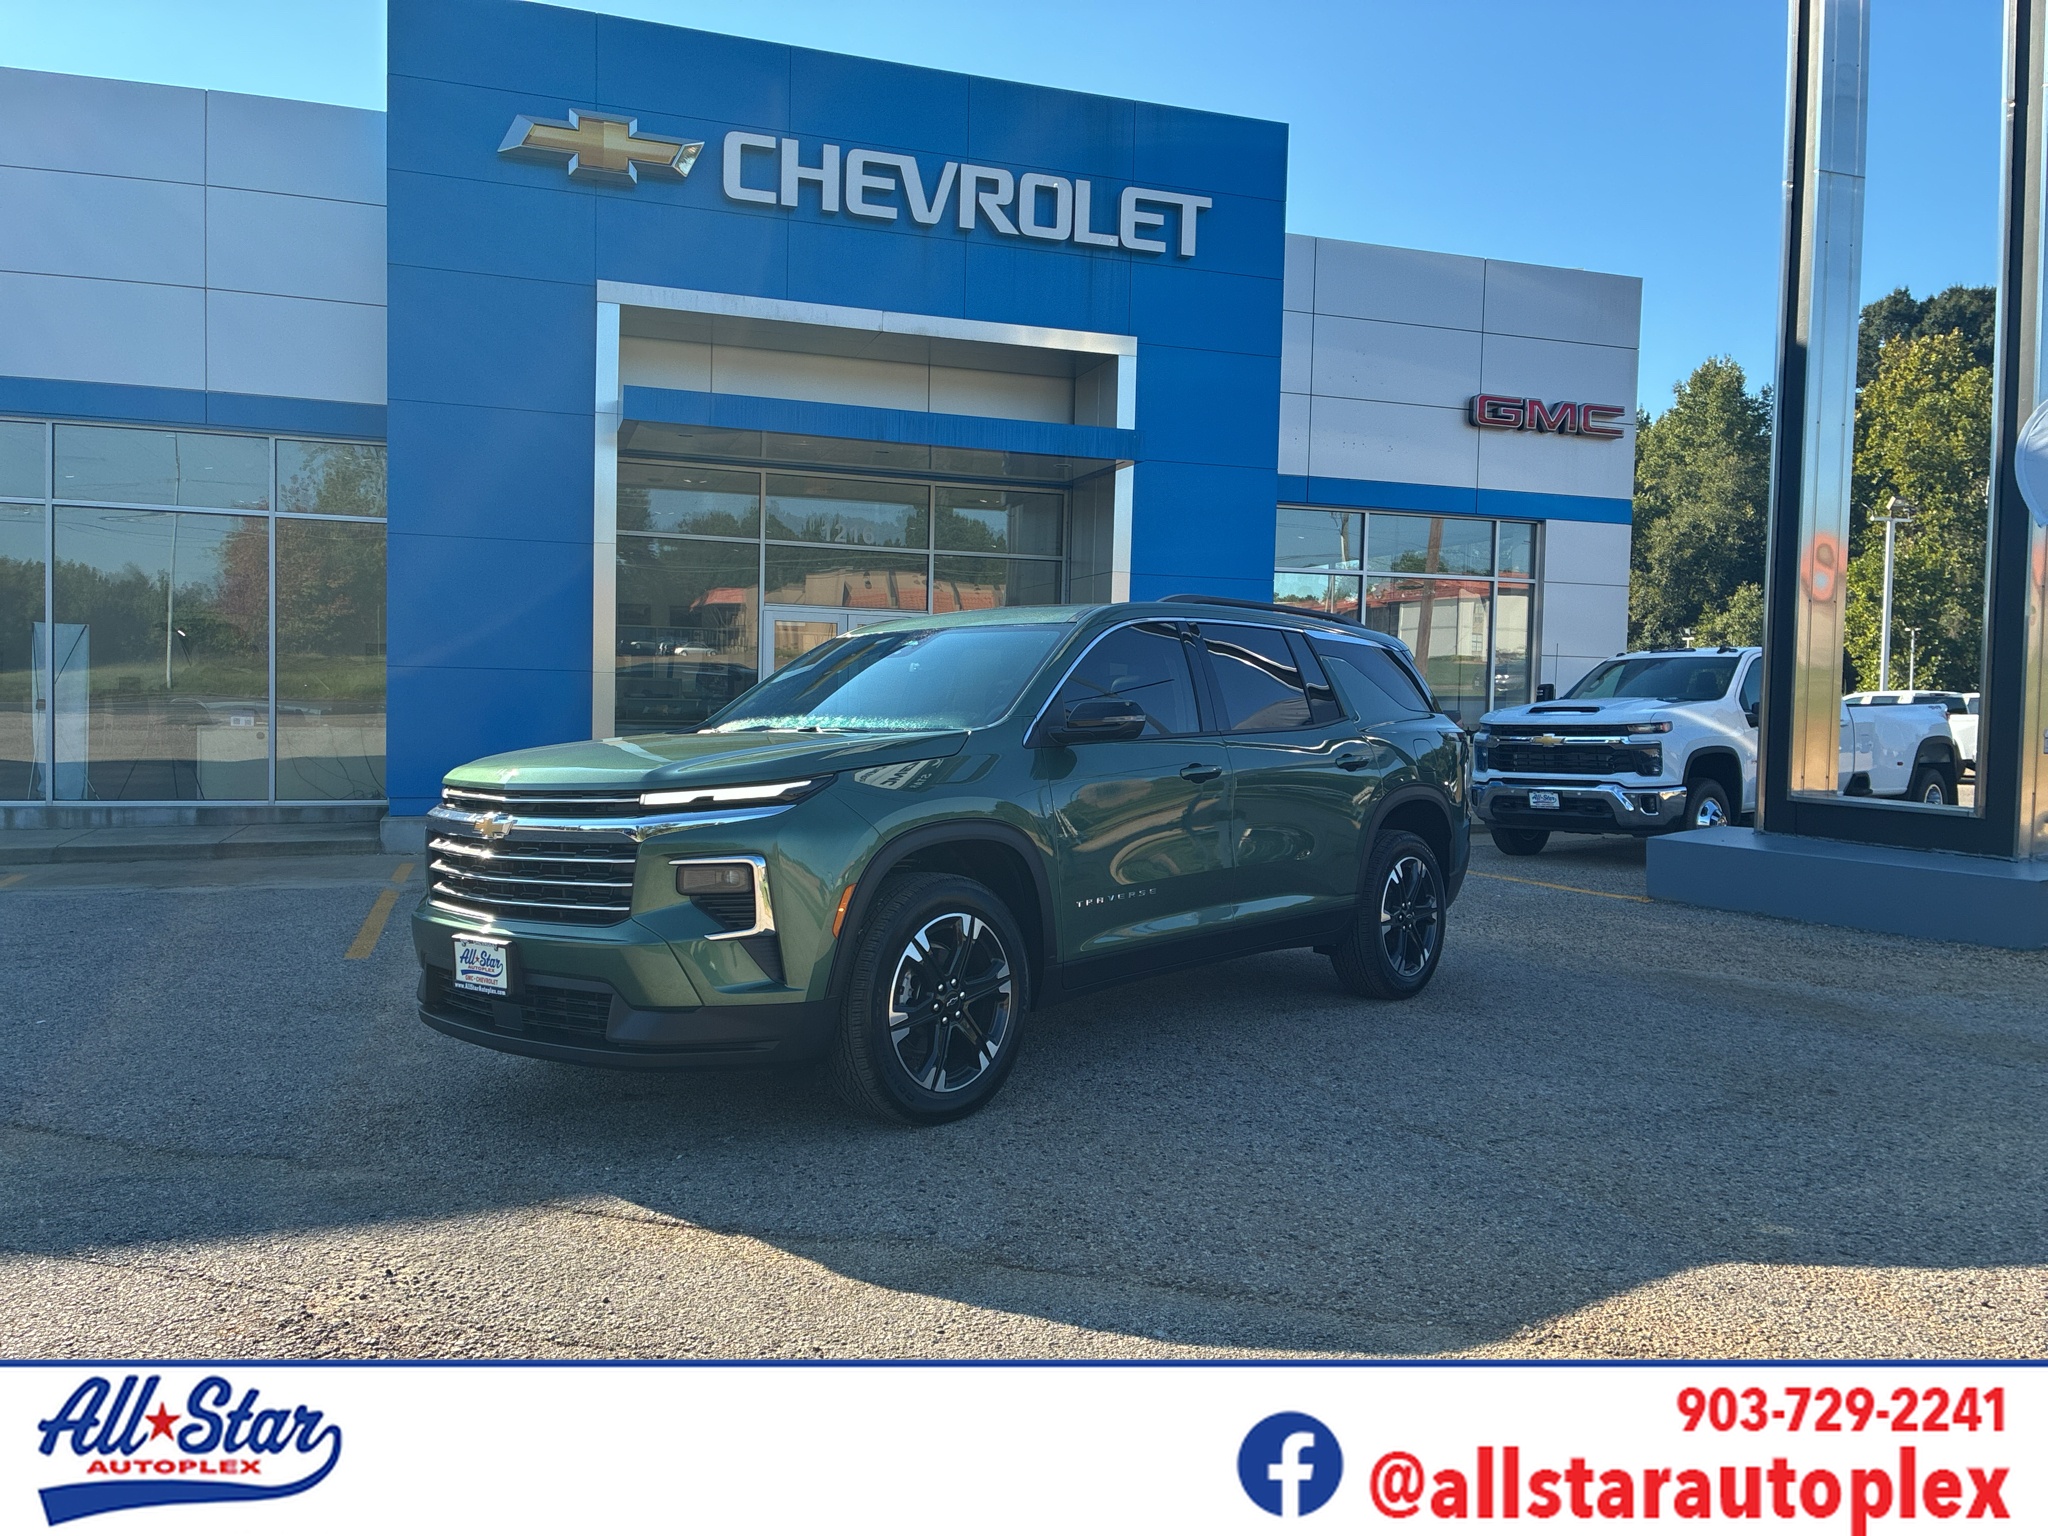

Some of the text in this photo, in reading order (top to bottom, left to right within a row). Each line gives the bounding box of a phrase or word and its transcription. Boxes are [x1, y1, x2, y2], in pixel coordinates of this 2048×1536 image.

[723, 131, 1213, 258] CHEVROLET
[1469, 393, 1626, 439] GMC
[821, 521, 875, 544] 1216
[1076, 888, 1157, 908] TRAVERSE
[480, 950, 501, 968] Star
[476, 976, 498, 986] CHEVROLET
